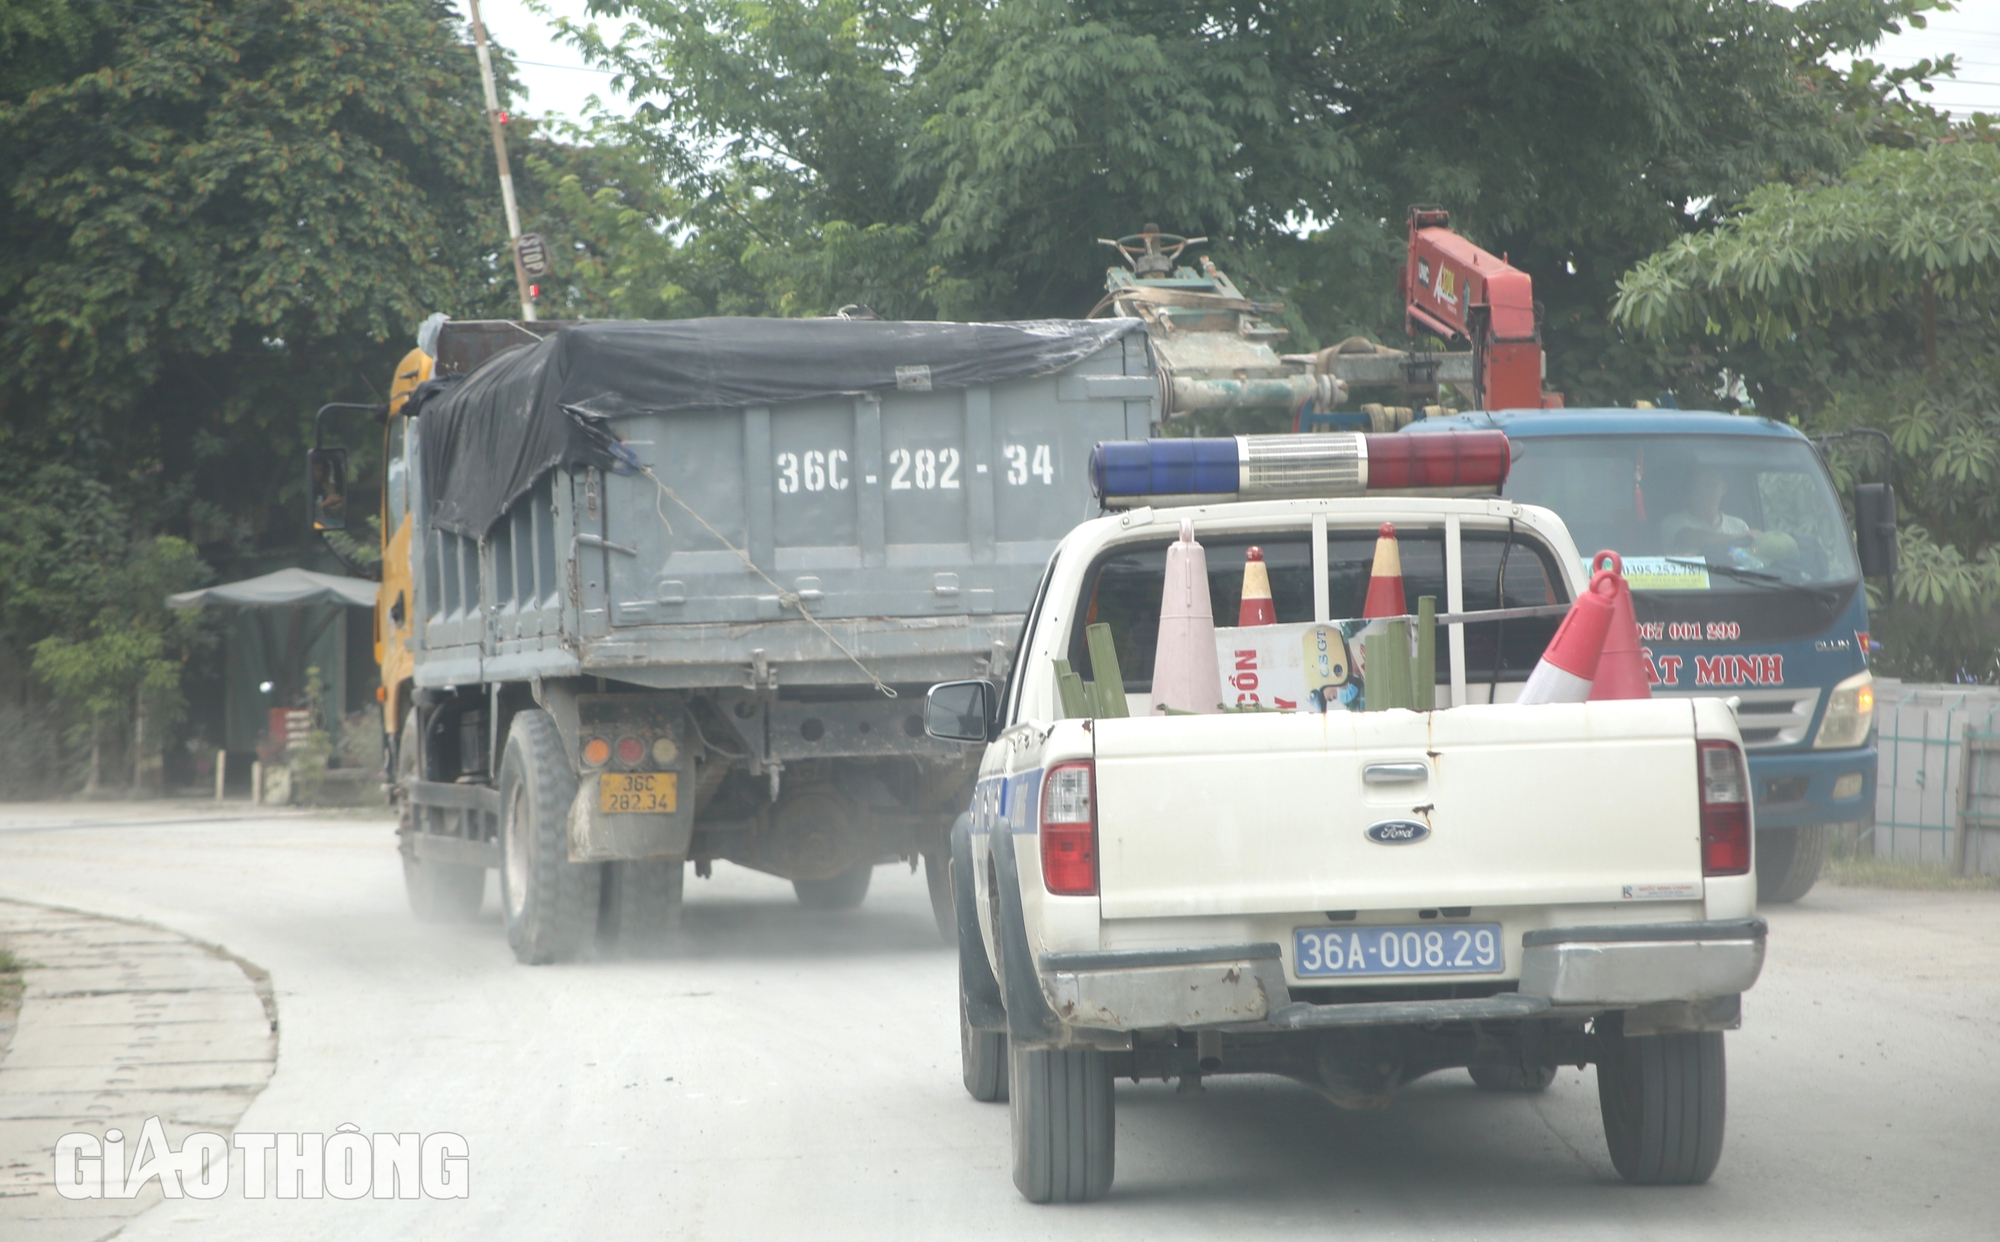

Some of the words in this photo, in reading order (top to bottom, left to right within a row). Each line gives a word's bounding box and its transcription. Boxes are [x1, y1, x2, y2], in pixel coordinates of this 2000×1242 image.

[519, 237, 545, 270] STOP
[777, 449, 849, 494] 36C
[889, 447, 960, 490] 282
[1006, 444, 1054, 485] 34
[1668, 621, 1704, 641] 001
[1706, 621, 1741, 641] 299
[1316, 629, 1330, 678] CSGT
[1694, 653, 1785, 687] MINH
[622, 775, 656, 792] 36C
[609, 793, 668, 811] 282.34
[1380, 823, 1415, 839] Ford
[1301, 928, 1496, 971] 36A-008.29
